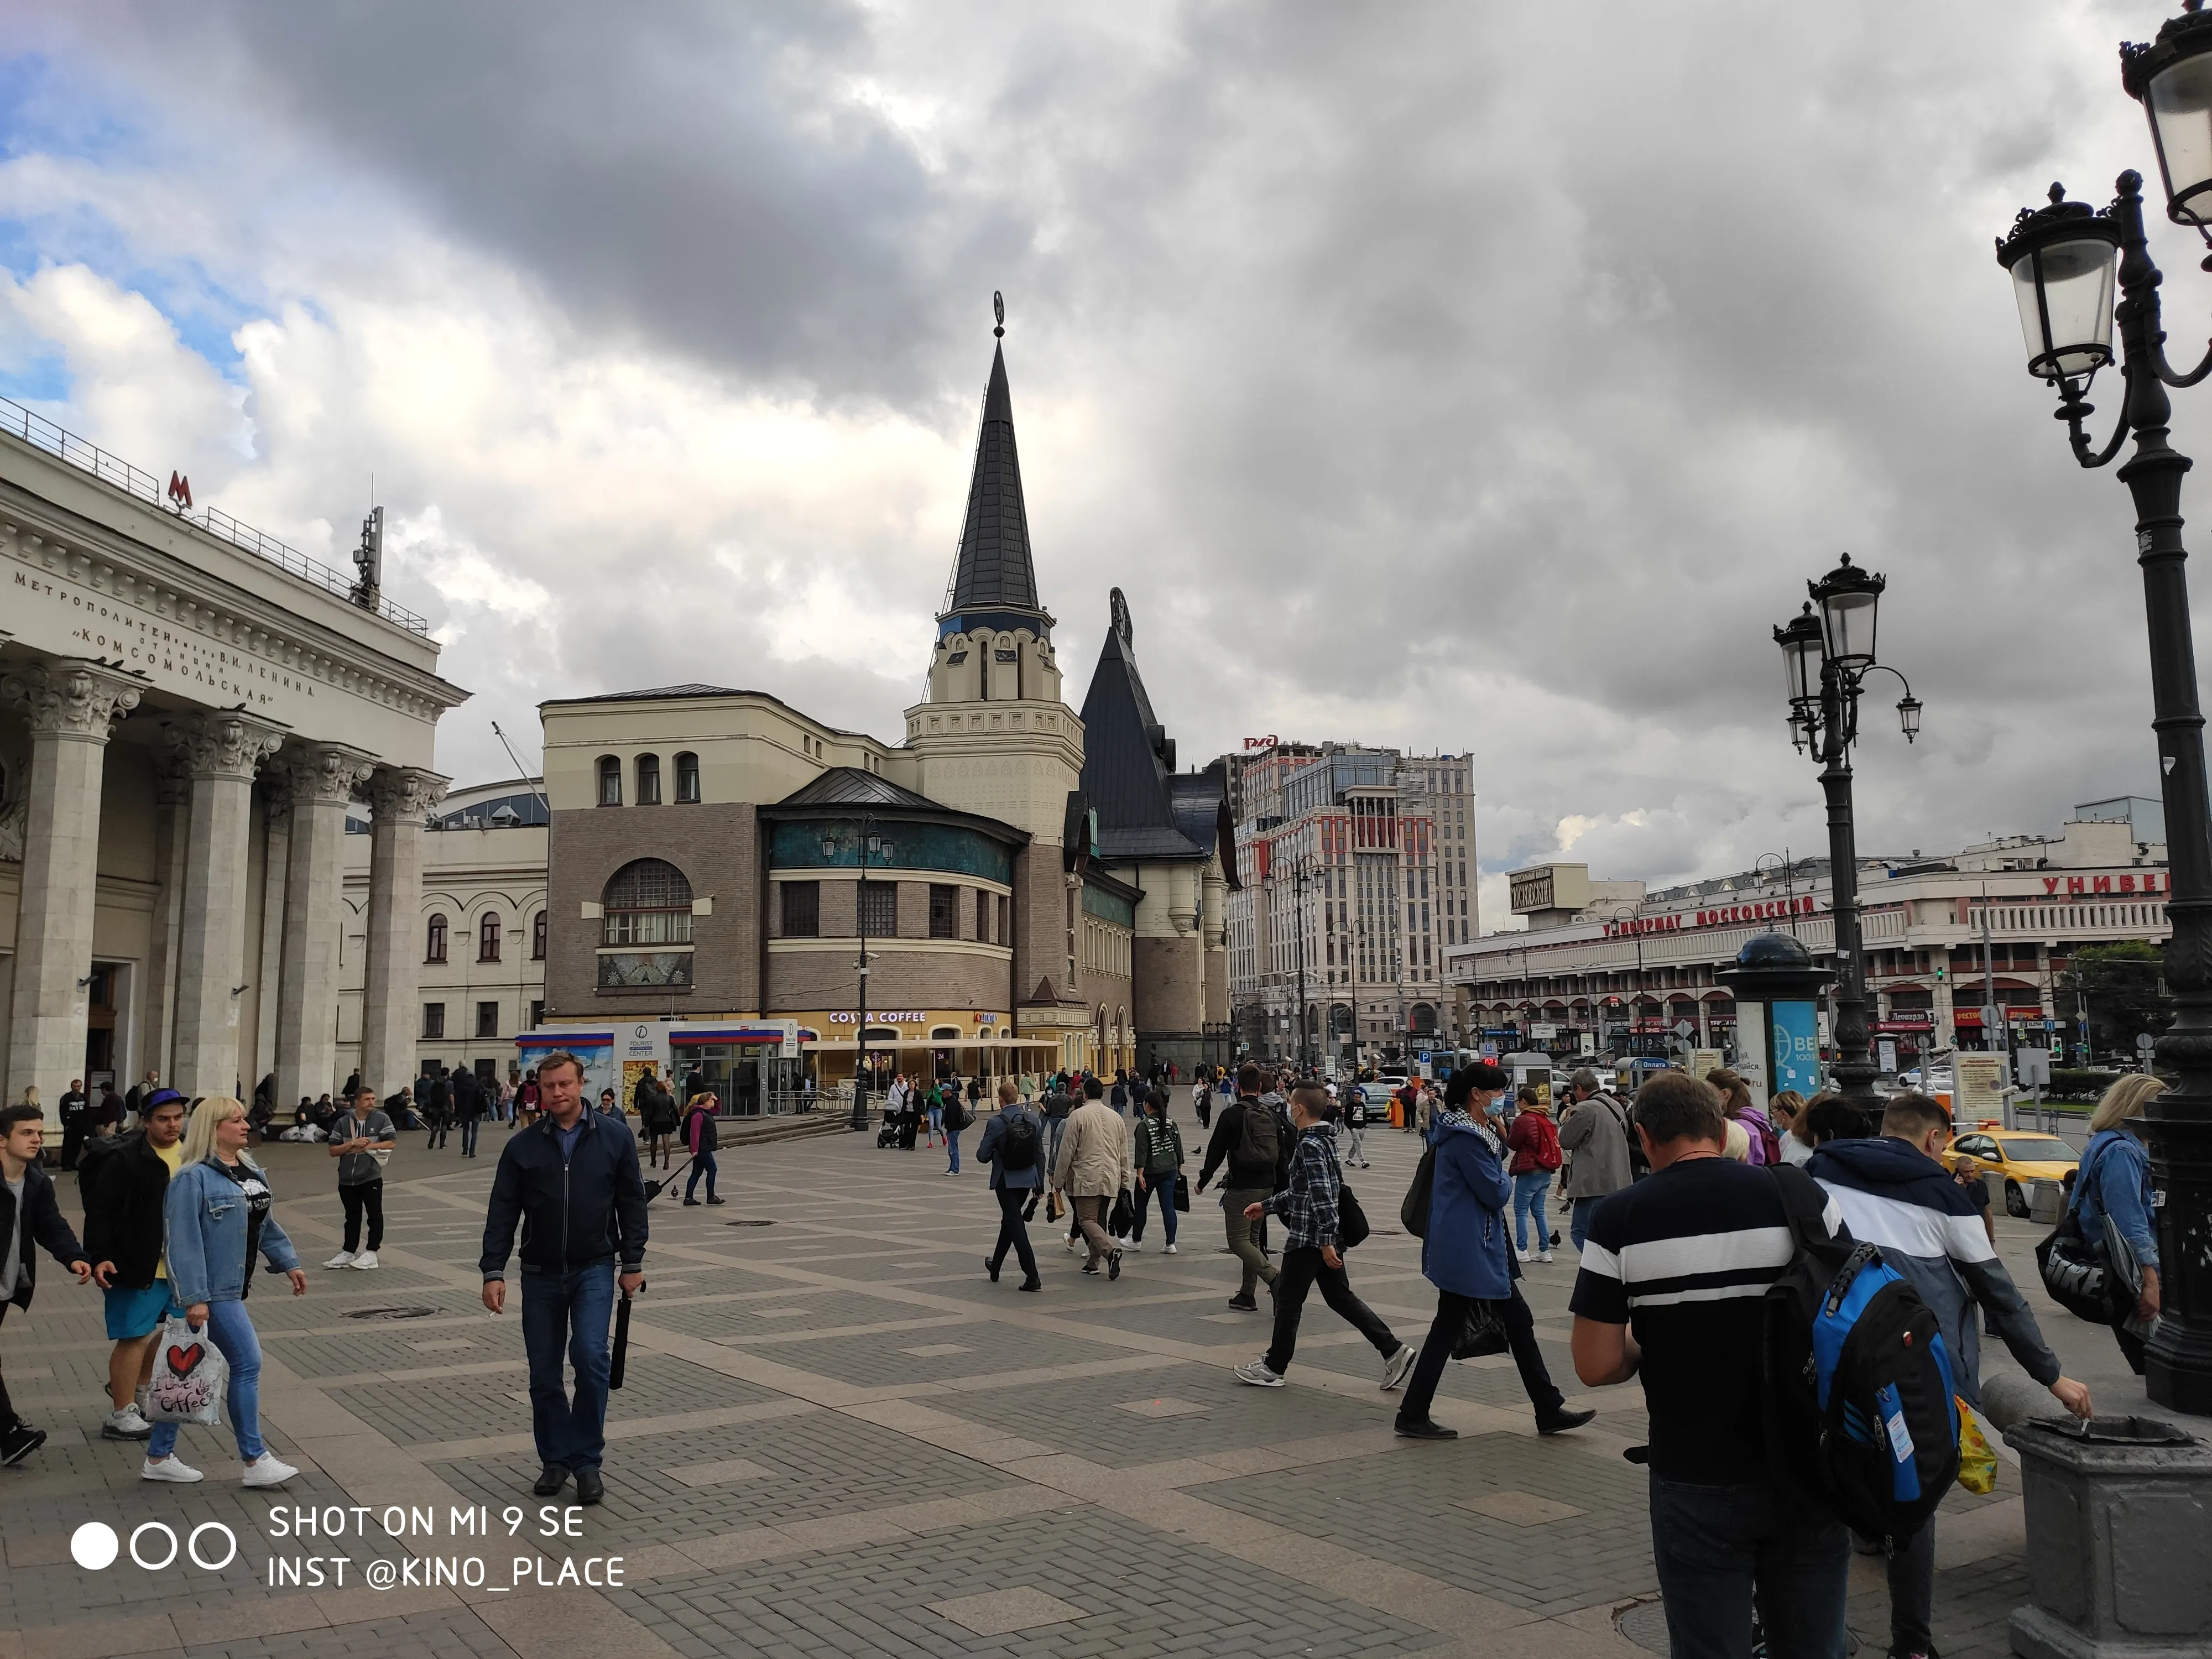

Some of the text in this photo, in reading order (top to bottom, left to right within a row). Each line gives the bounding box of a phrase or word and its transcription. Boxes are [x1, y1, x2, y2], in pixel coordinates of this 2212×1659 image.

[14, 571, 171, 642] МЕТРОПОЛИТЕН
[1696, 895, 1814, 926] МОСКОВСКИЙ
[879, 1013, 926, 1022] COFFEE
[1892, 1013, 1924, 1022] Леонардо
[1422, 1053, 1428, 1062] P
[165, 1382, 192, 1390] Love
[160, 1392, 214, 1413] Coffee
